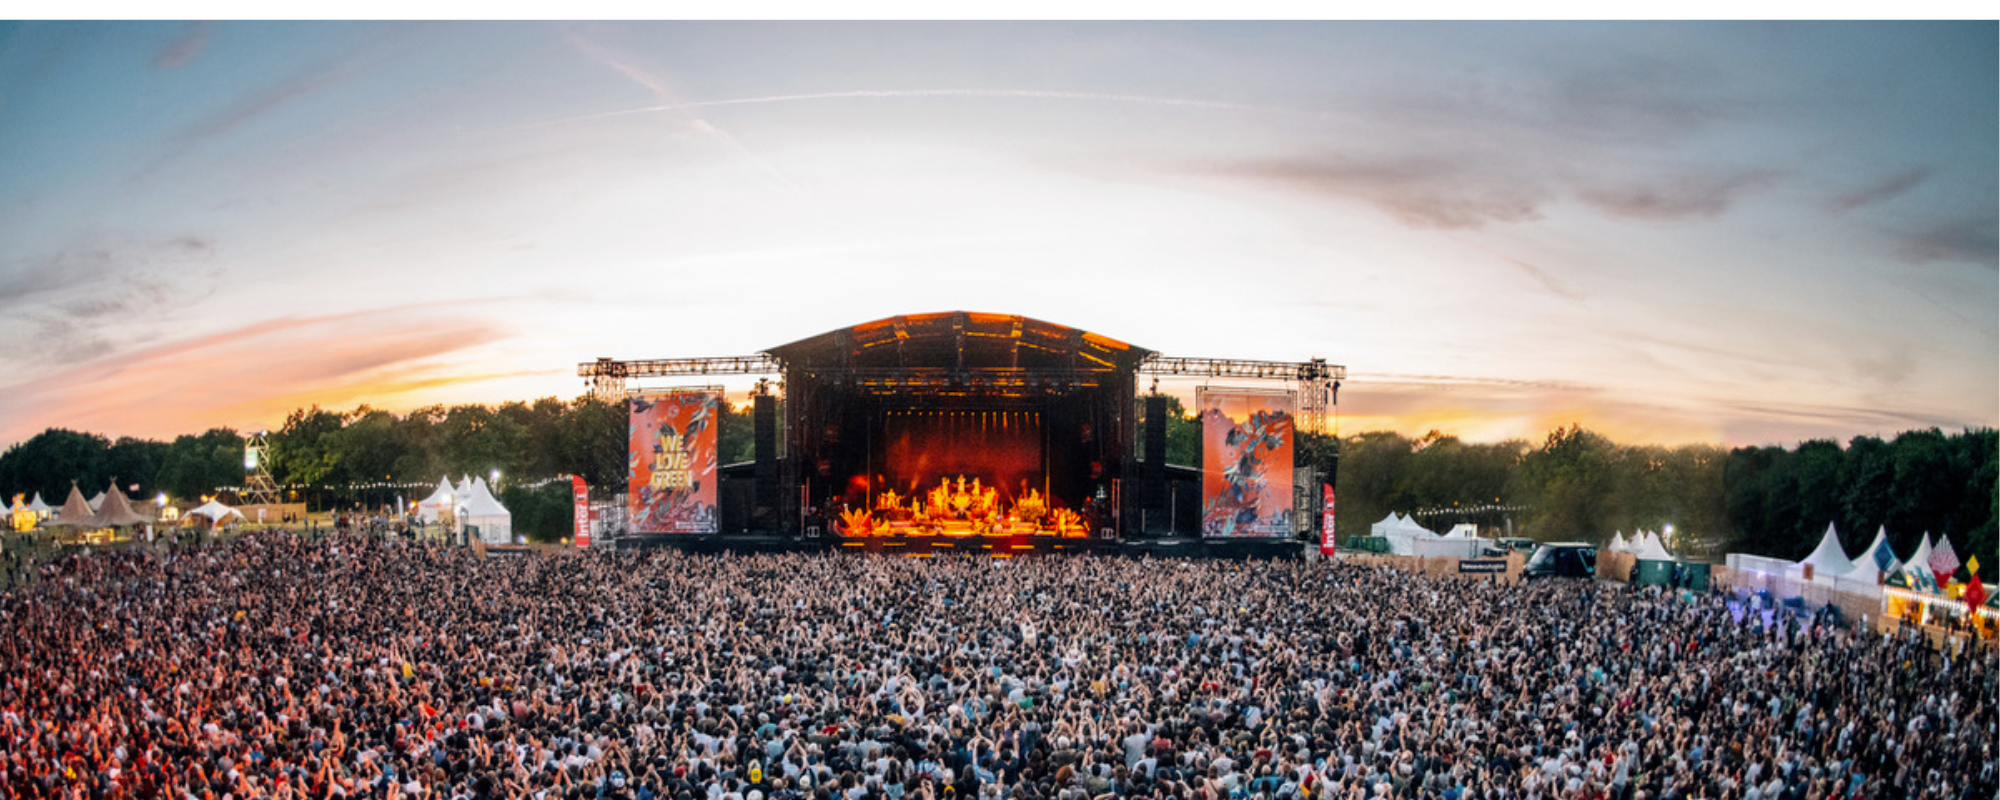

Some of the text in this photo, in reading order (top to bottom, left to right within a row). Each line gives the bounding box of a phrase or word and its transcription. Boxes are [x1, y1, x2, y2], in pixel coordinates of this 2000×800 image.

[661, 435, 684, 452] WE
[656, 452, 689, 470] LOVE
[651, 470, 694, 489] GREEN
[577, 504, 589, 537] inter
[1323, 514, 1335, 548] inter
